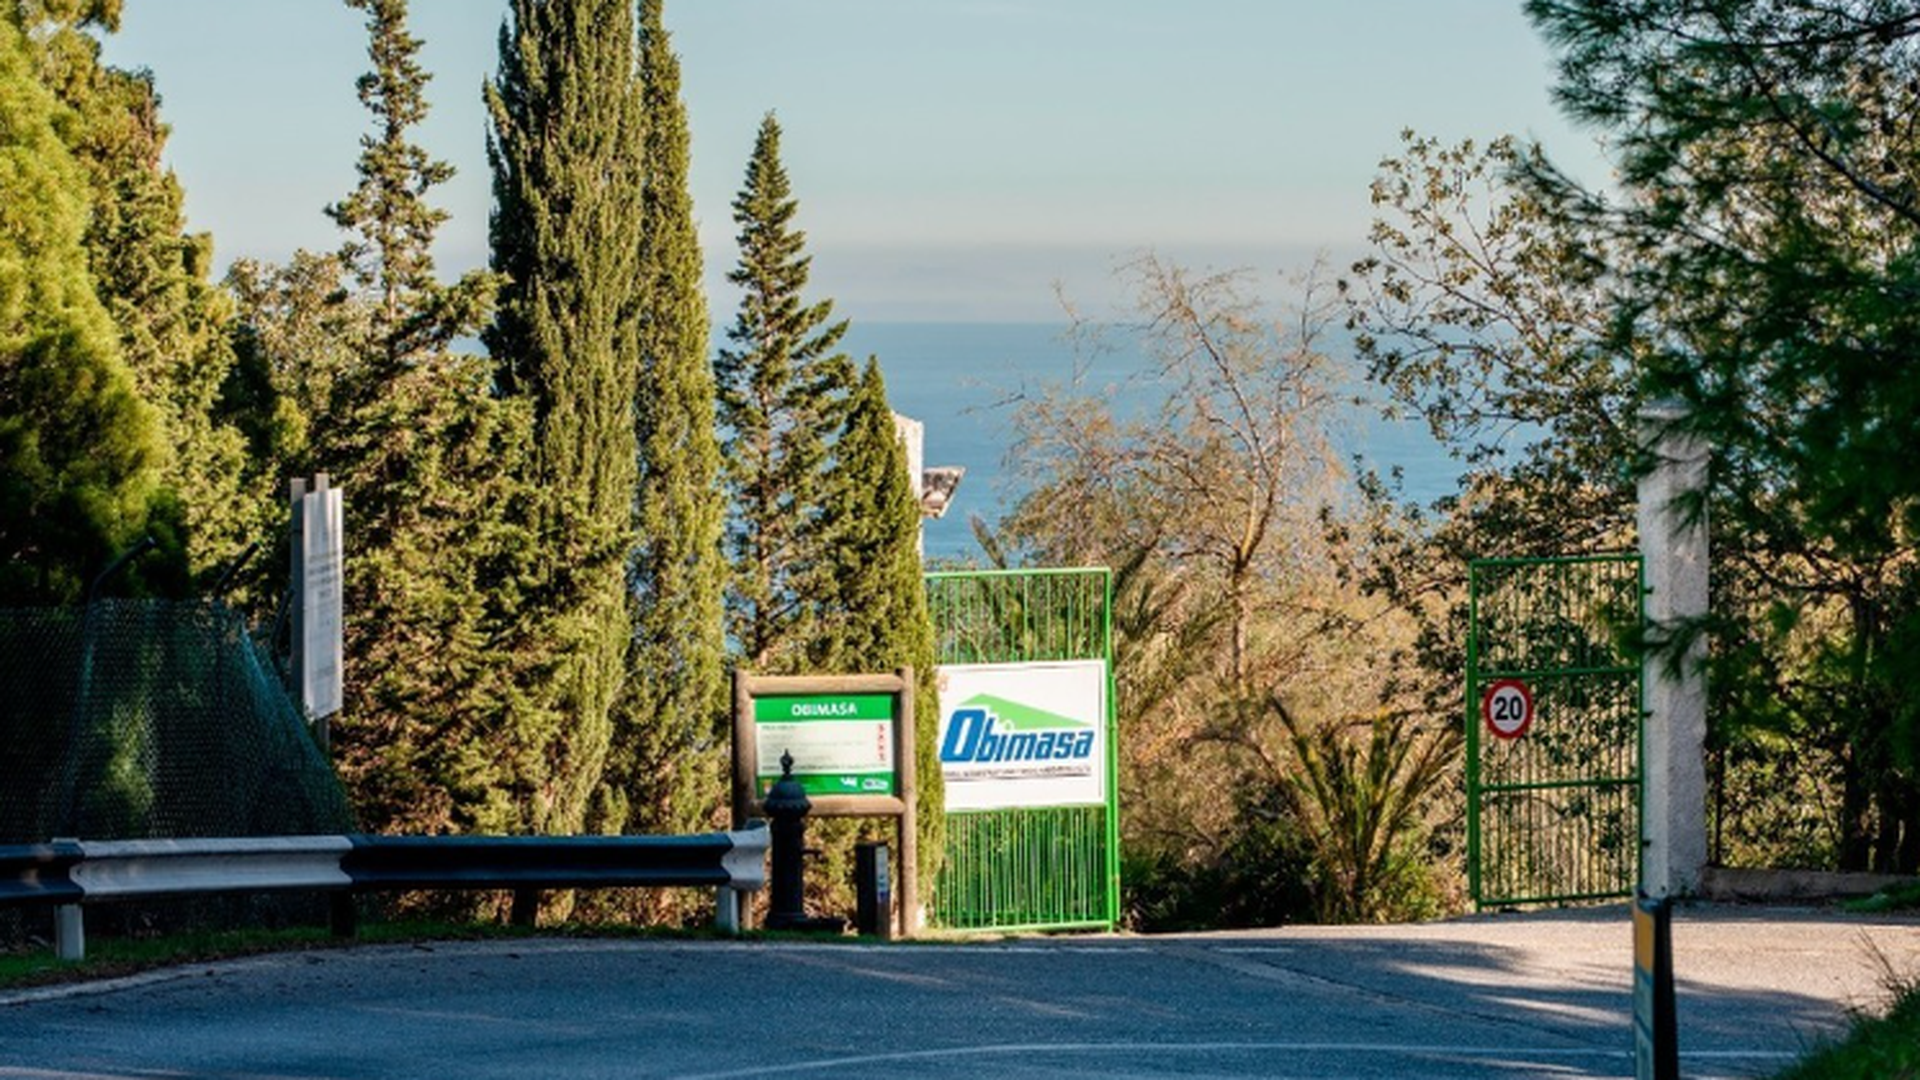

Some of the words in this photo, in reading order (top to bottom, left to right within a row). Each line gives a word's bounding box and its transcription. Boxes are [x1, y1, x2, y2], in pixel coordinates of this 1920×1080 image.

[791, 702, 858, 716] OBIMASA
[1494, 696, 1523, 720] 20
[941, 709, 1095, 763] Obimasa
